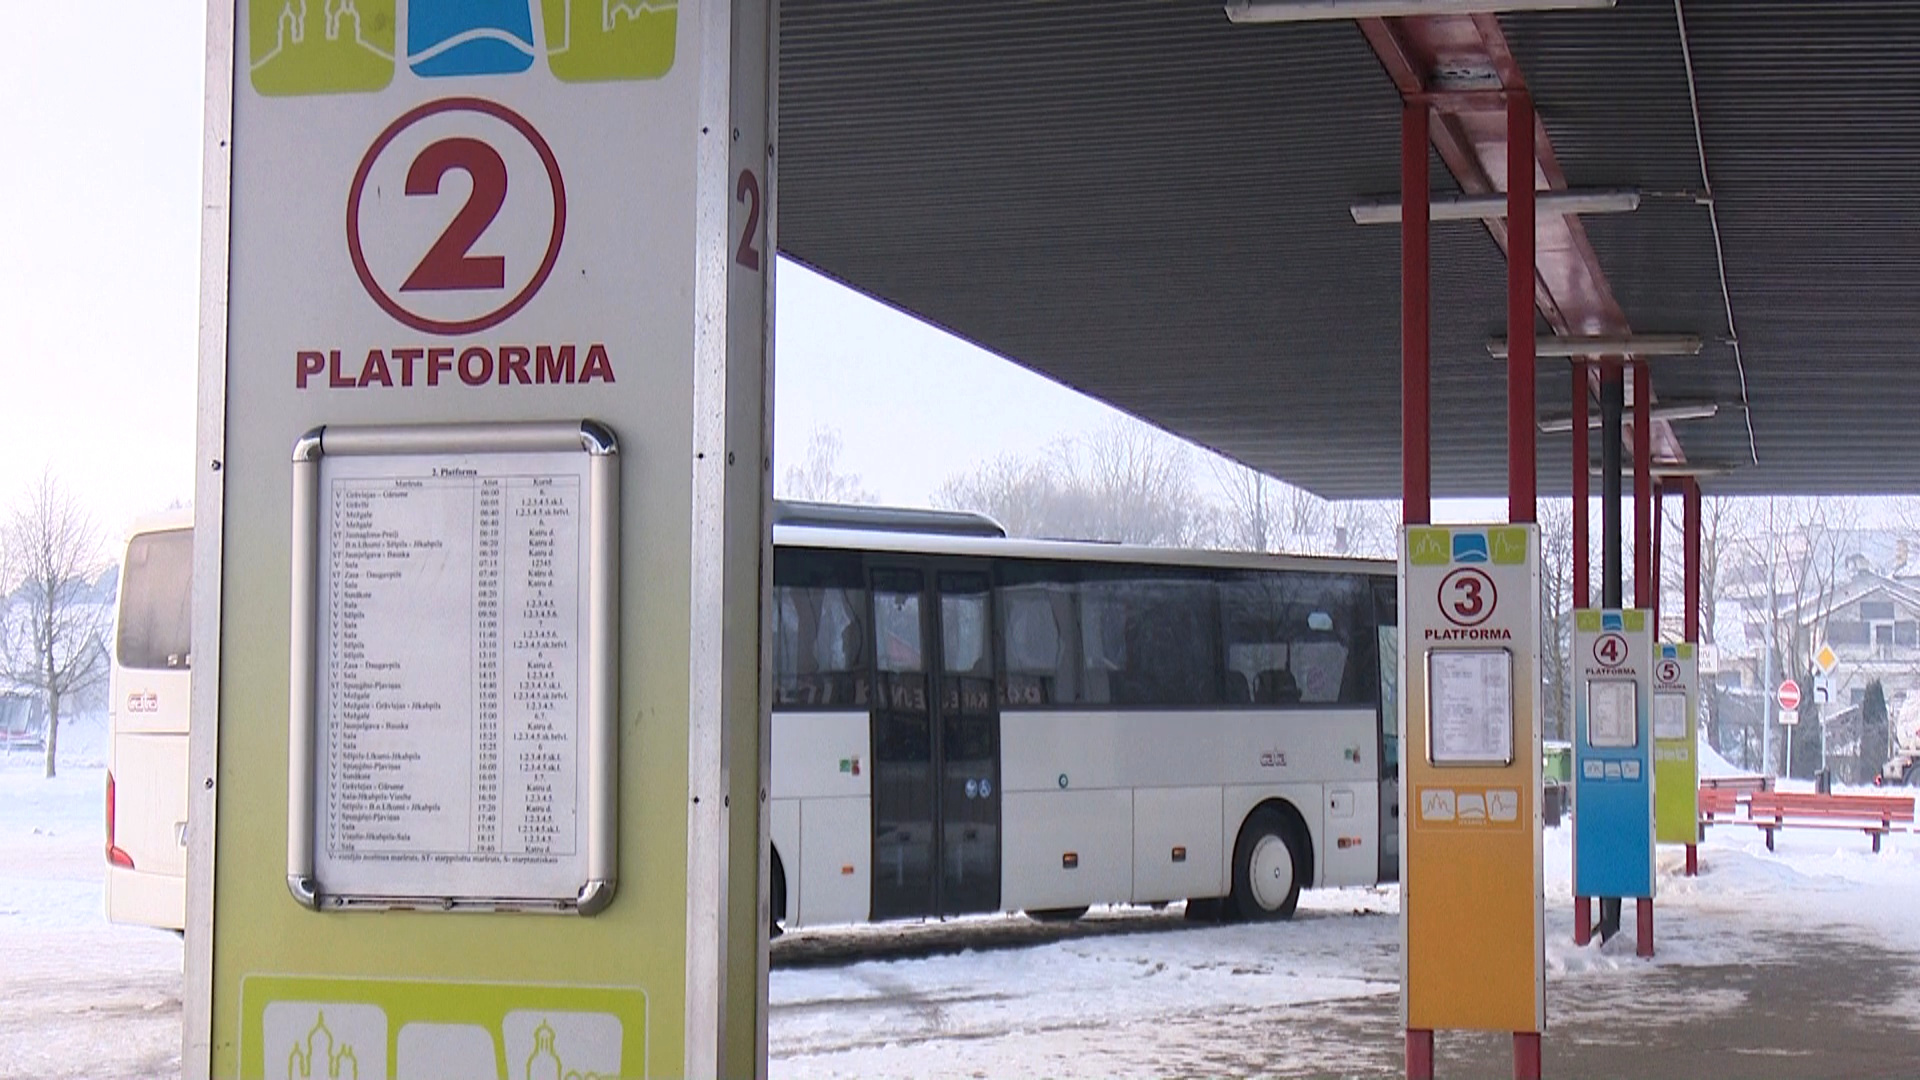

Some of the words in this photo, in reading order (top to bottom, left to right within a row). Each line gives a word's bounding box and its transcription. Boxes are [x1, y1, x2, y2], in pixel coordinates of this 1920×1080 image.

[398, 137, 508, 292] 2
[736, 168, 760, 271] 2
[295, 344, 616, 389] PLATFORMA
[440, 468, 478, 476] Platforma
[1453, 577, 1484, 617] 3
[1424, 627, 1512, 640] PLATFORMA
[1600, 639, 1619, 662] 4
[1585, 668, 1636, 676] PLATFORMA
[1662, 664, 1675, 681] 5
